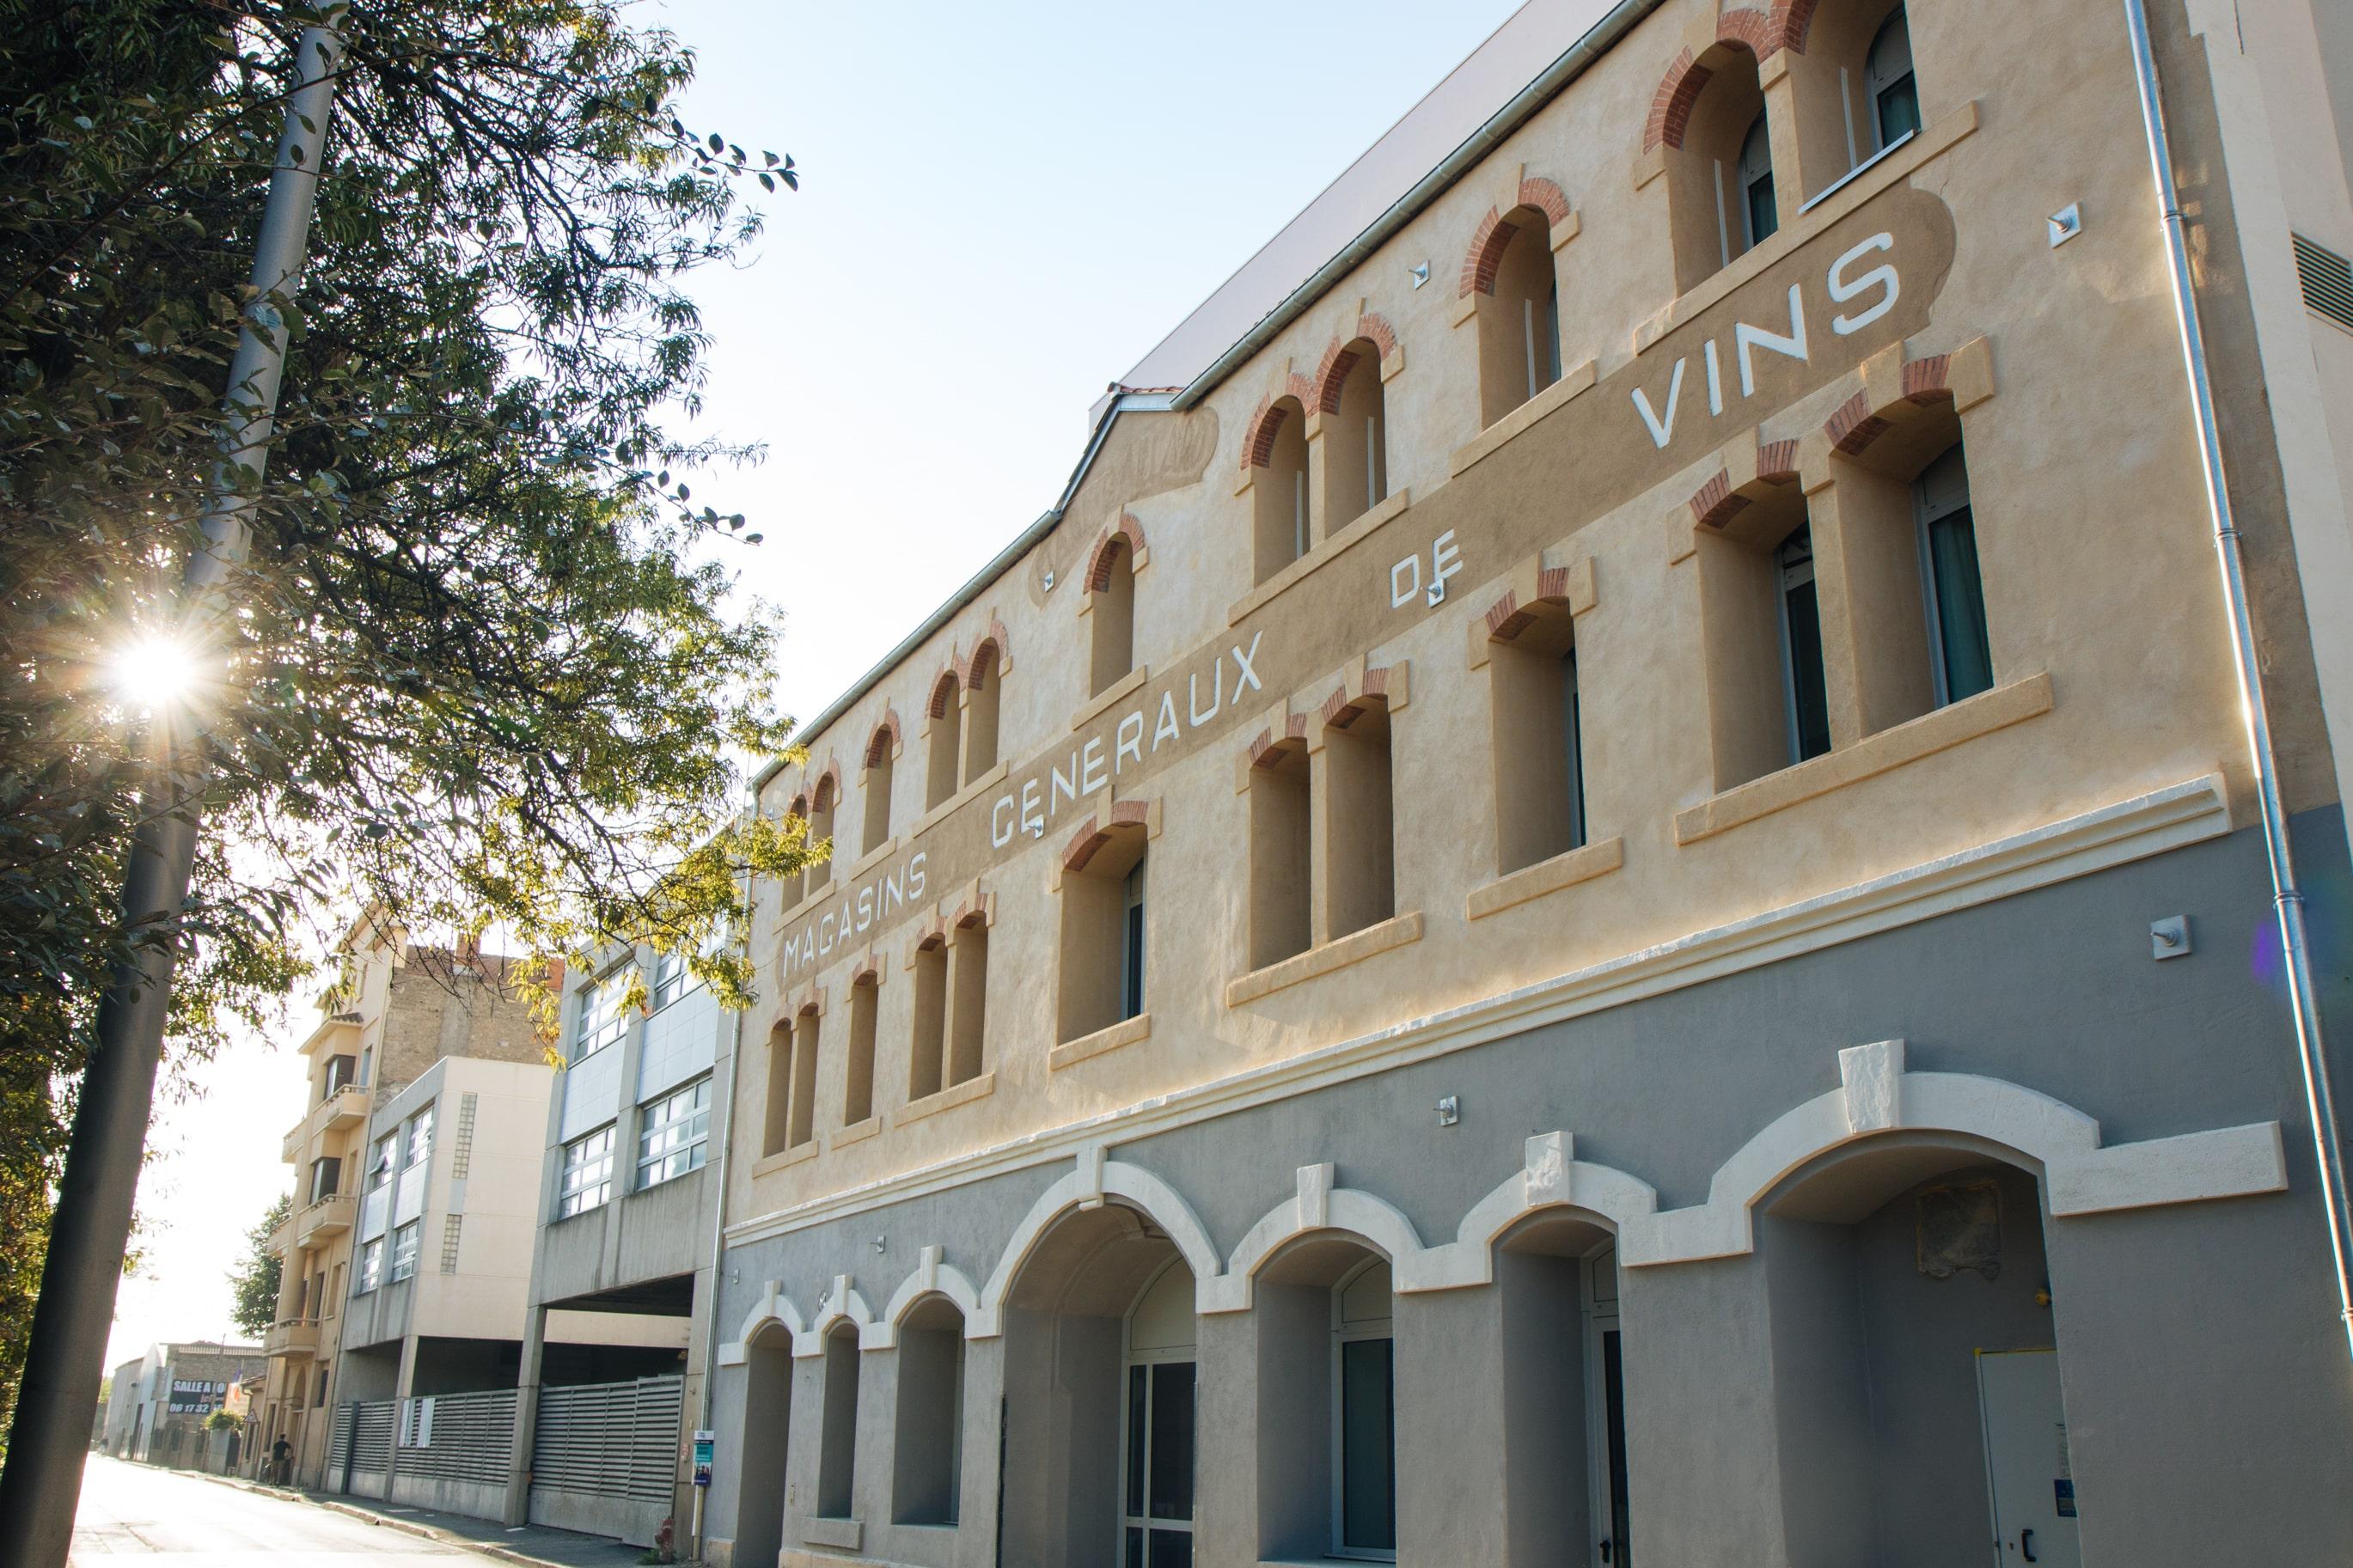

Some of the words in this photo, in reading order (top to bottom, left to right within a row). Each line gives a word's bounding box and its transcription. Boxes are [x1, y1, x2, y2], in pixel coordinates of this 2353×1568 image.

[783, 851, 926, 979] MAGASINS
[992, 630, 1263, 849] GENERAUX
[1390, 528, 1464, 608] DE
[1630, 231, 1901, 449] VINS
[174, 1380, 203, 1393] SALLE
[203, 1382, 211, 1393] A
